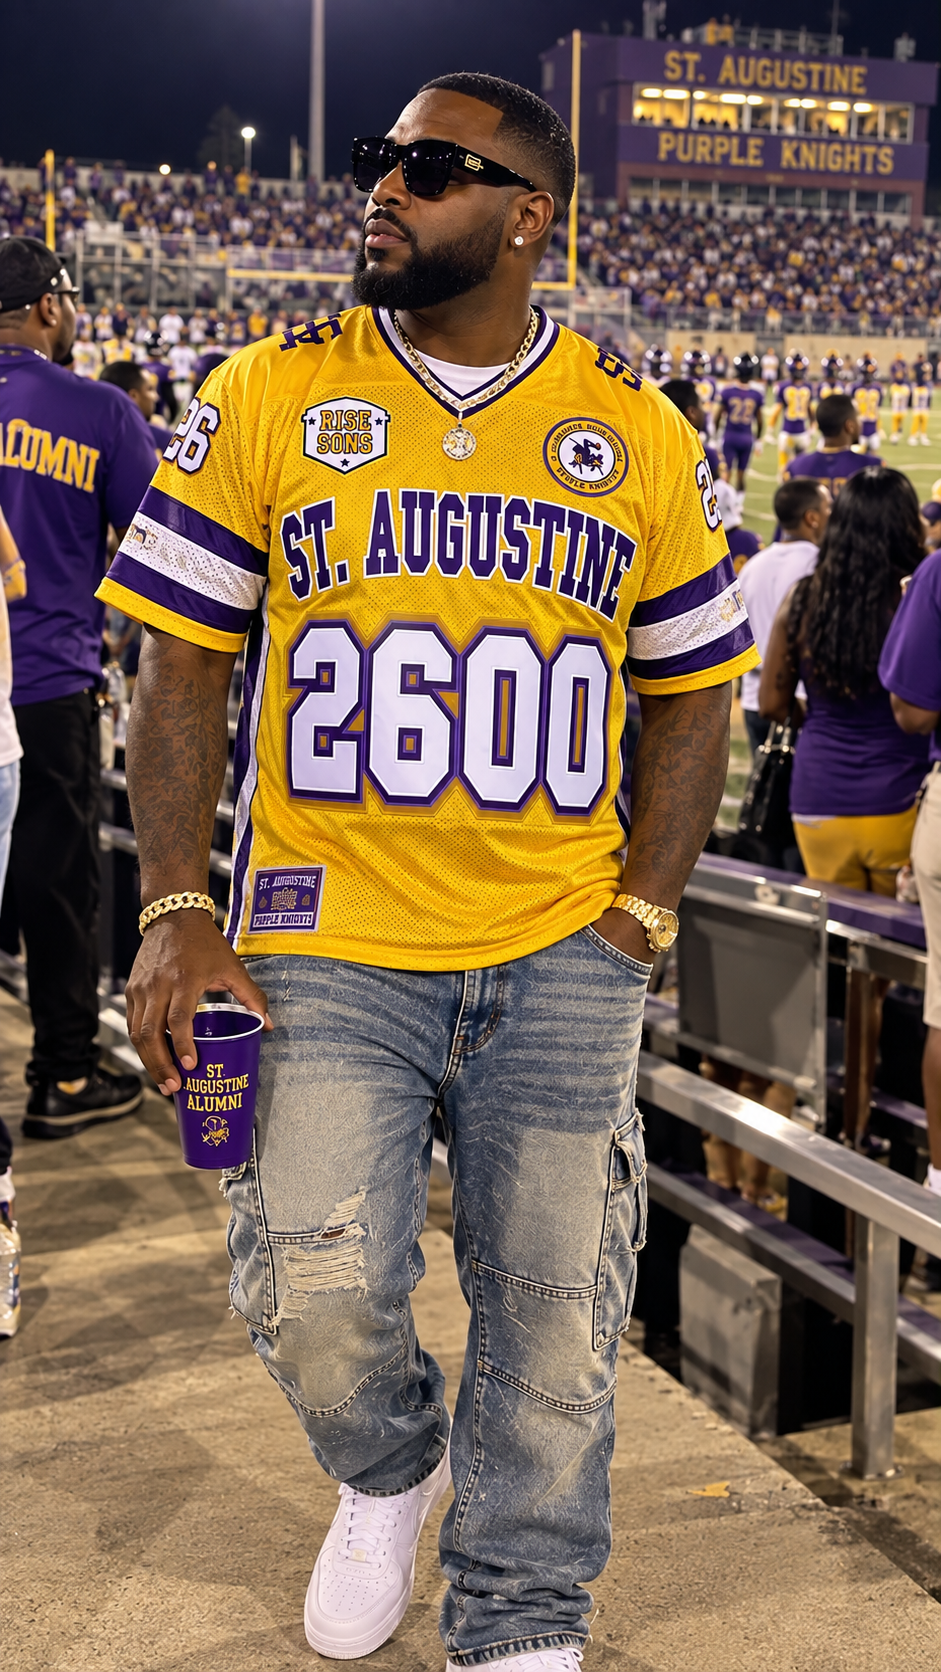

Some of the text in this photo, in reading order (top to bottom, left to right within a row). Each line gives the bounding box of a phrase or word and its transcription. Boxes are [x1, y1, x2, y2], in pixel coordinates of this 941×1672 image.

[664, 50, 868, 94] ST. AUGUSTINE
[659, 131, 894, 175] PURPLE KNIGHTS
[320, 410, 372, 431] RISE
[0, 418, 100, 493] LUMNI
[317, 432, 373, 454] SONS
[279, 488, 638, 623] ST. AUGUSTINE
[286, 617, 614, 817] 2600
[206, 1063, 226, 1078] ST.
[187, 1092, 243, 1112] ALUMNI
